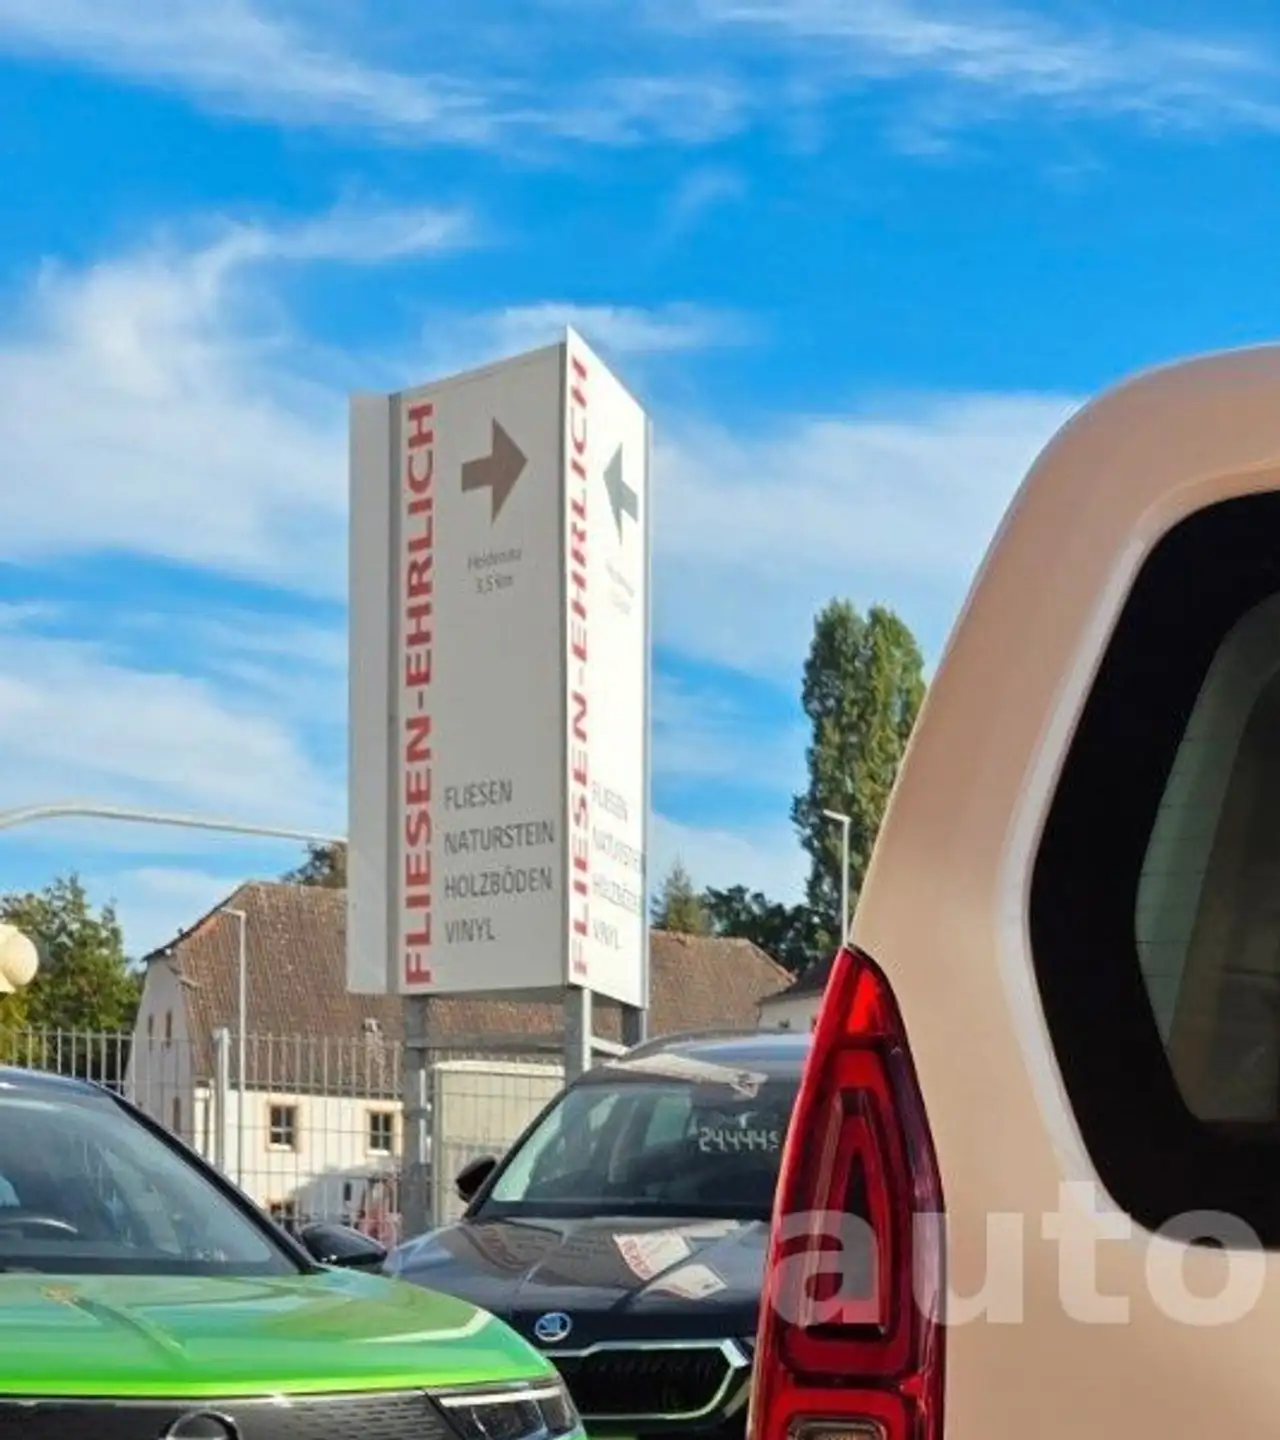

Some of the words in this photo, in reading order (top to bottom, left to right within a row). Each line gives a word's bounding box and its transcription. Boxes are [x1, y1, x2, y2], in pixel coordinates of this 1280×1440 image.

[405, 403, 434, 985] FLIESEN-EHRLICH
[444, 779, 512, 812] FLIESEN
[444, 819, 555, 855] NATURSTEIN
[444, 865, 553, 900] HOLZBÖDEN
[445, 917, 496, 944] VINYL
